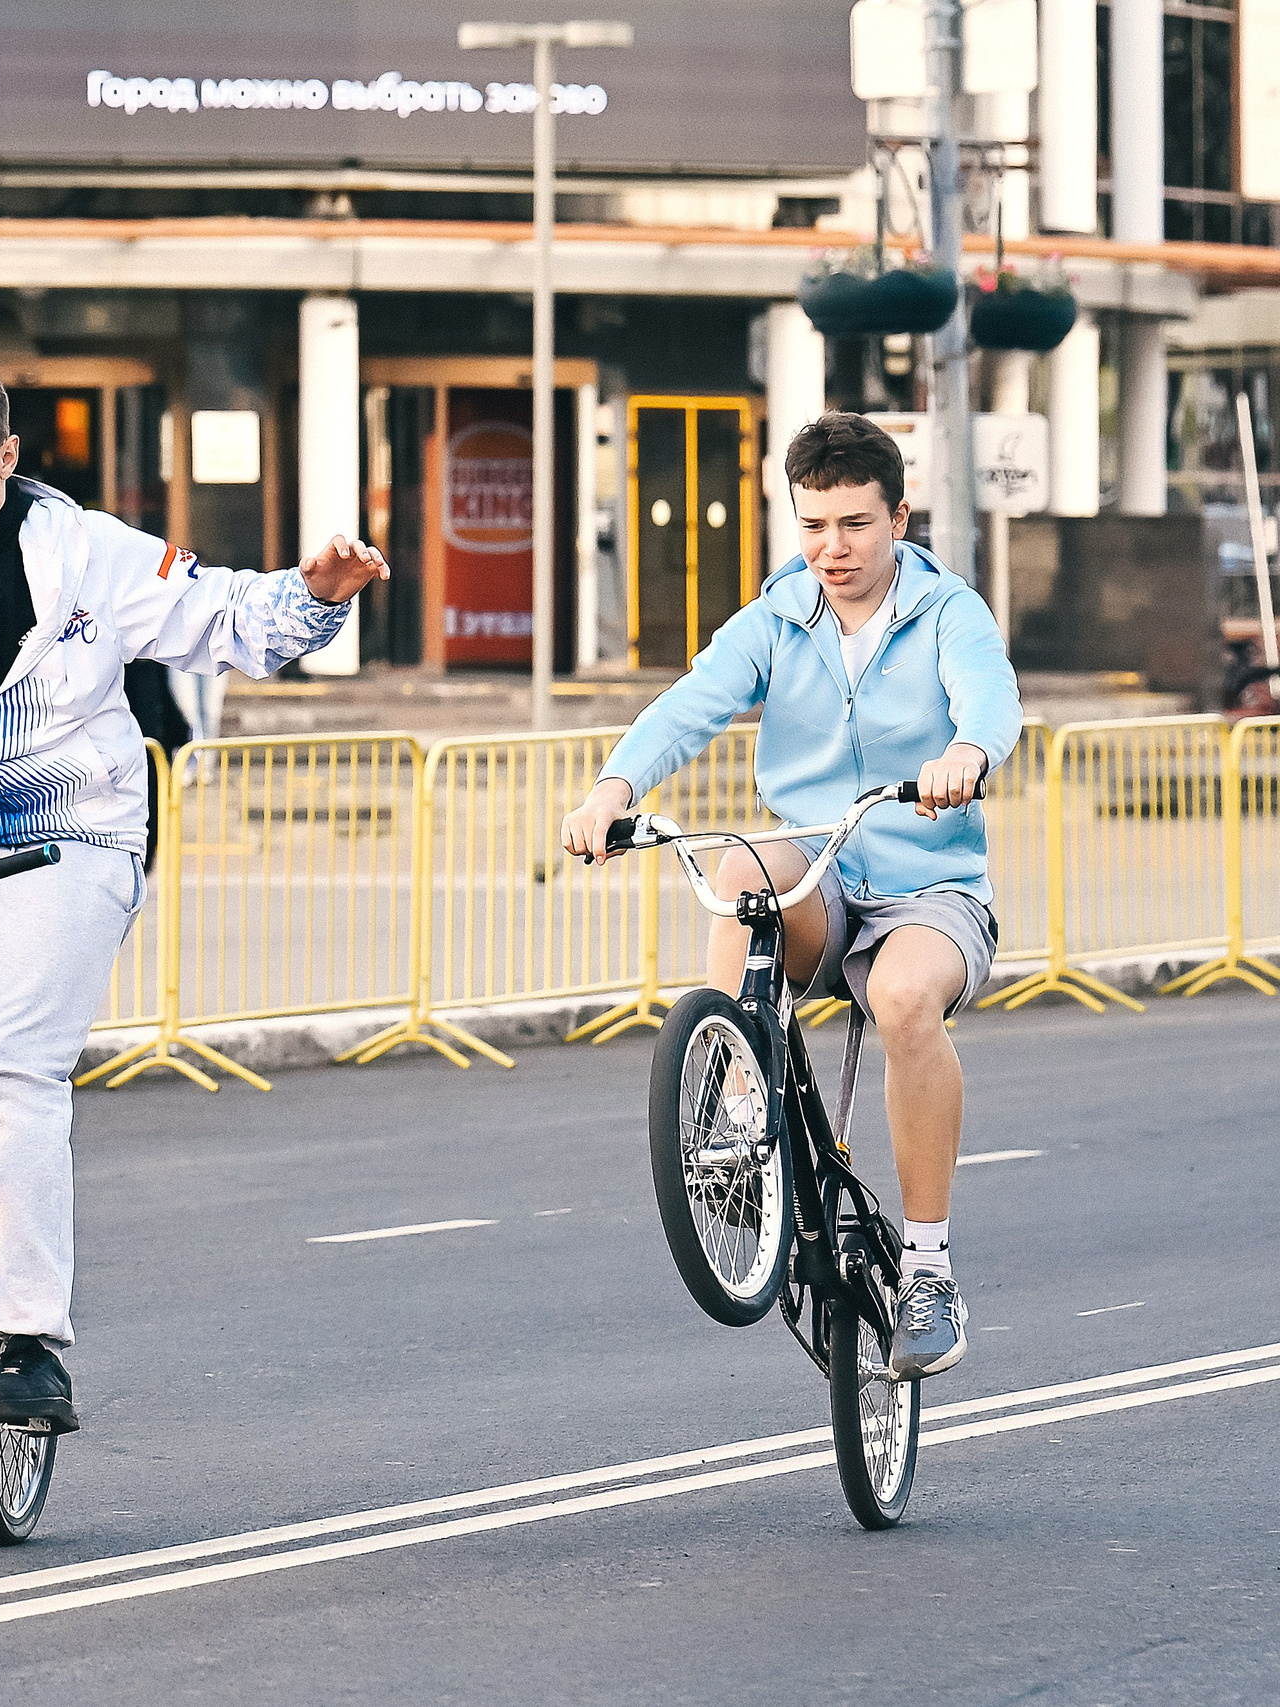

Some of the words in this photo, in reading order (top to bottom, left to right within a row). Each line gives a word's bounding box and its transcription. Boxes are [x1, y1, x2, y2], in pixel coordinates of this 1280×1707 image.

[87, 70, 199, 115] Город
[201, 78, 329, 109] можно
[331, 71, 483, 118] выбрать
